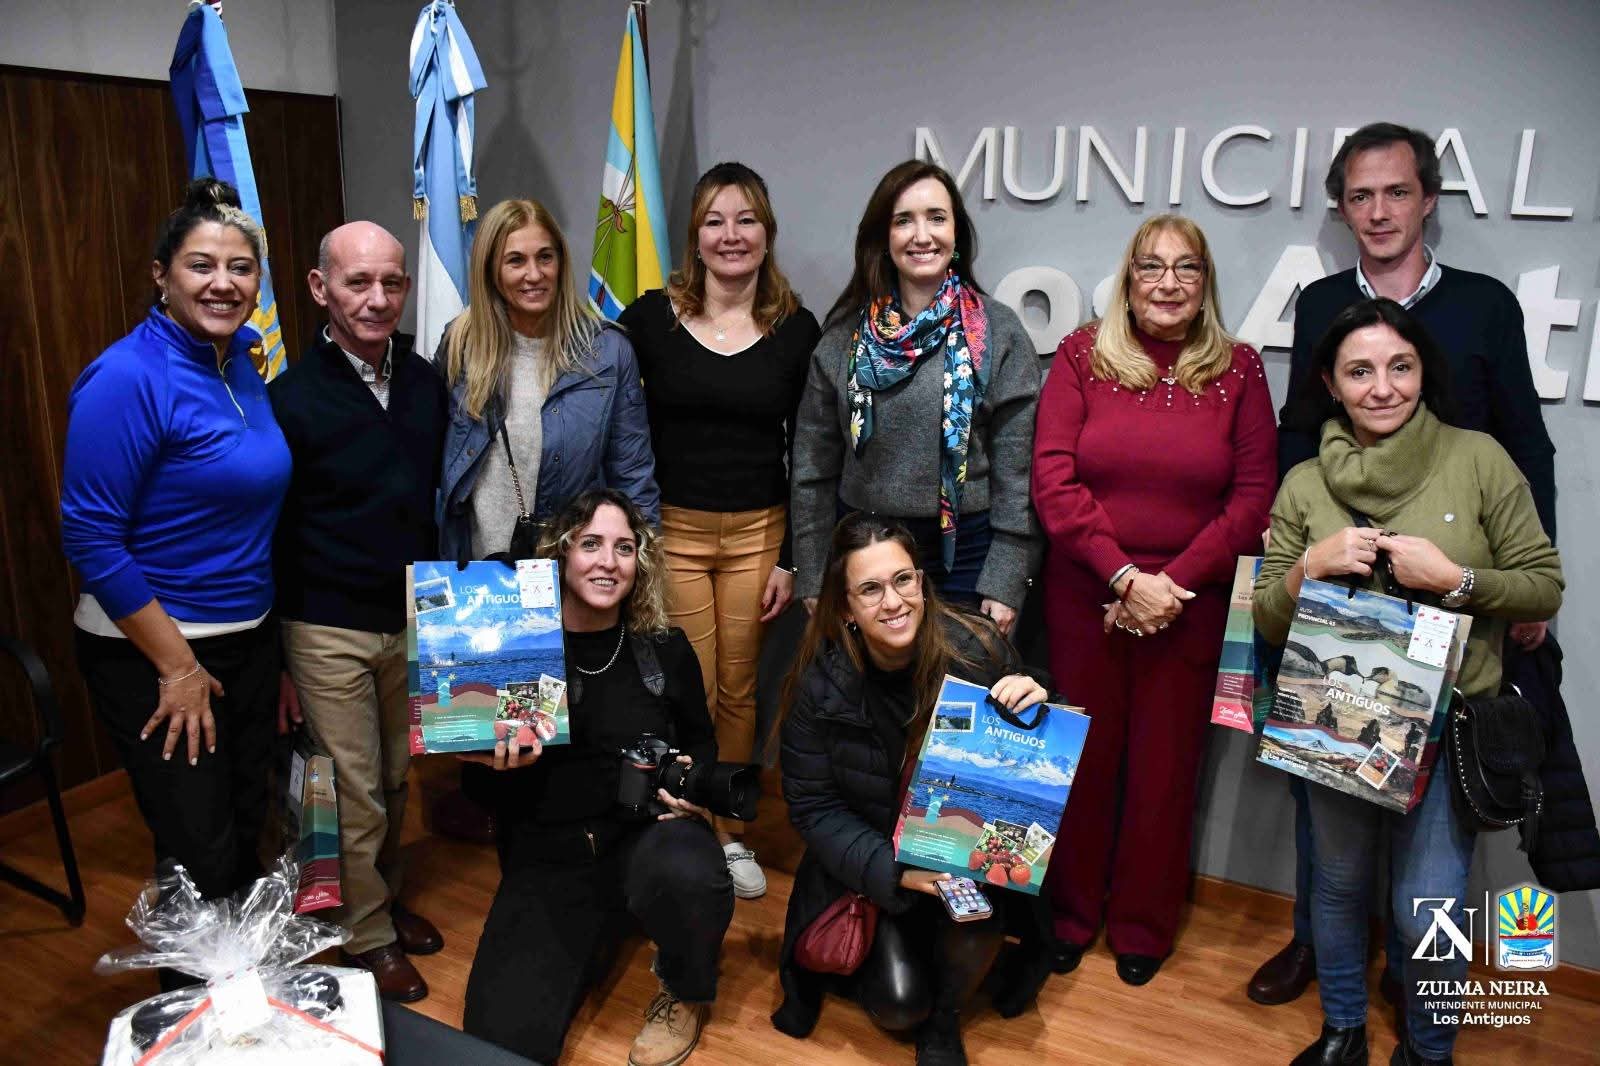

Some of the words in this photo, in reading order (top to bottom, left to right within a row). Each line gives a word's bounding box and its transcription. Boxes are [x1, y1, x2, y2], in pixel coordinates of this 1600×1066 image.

[467, 594, 523, 605] ANTIGUO
[1297, 612, 1329, 625] PROVINCIAL
[1321, 675, 1344, 689] LOS
[1325, 687, 1392, 716] ANTIGUOS
[982, 713, 1001, 726] LOS
[984, 725, 1047, 750] ANTIGUOS
